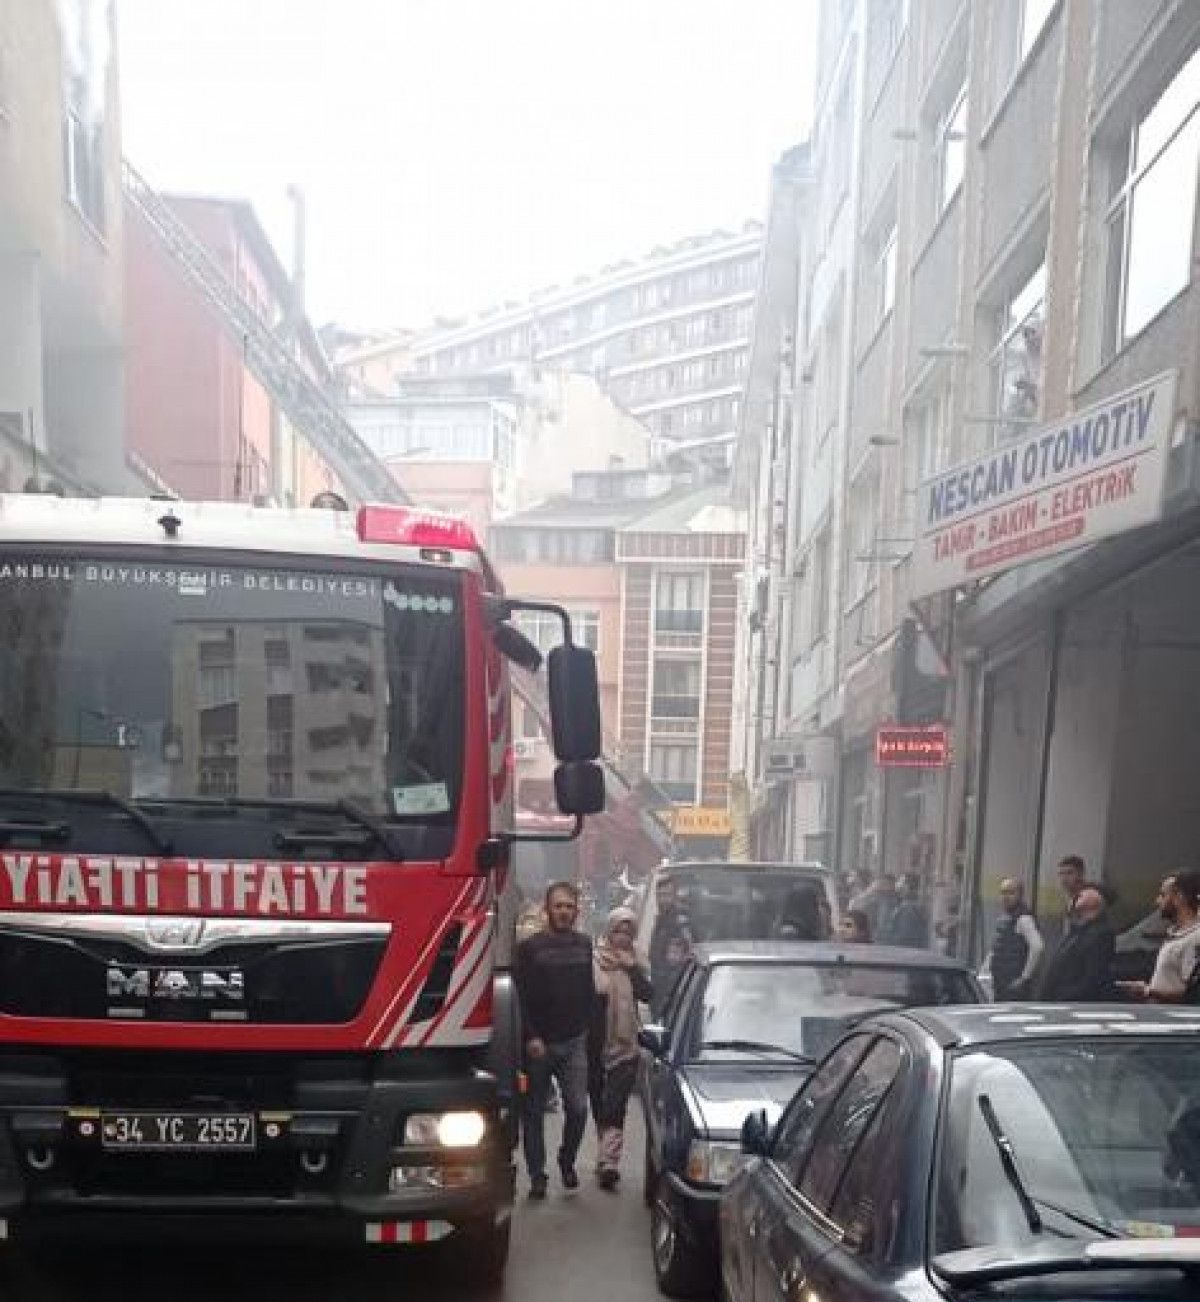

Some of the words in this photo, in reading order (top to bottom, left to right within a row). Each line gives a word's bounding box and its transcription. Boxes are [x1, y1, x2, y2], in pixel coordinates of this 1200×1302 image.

[928, 449, 1018, 526] NESCAN
[106, 967, 245, 999] MAN
[116, 1117, 143, 1143] 34
[157, 1117, 184, 1142] YC
[198, 1117, 251, 1142] 2557
